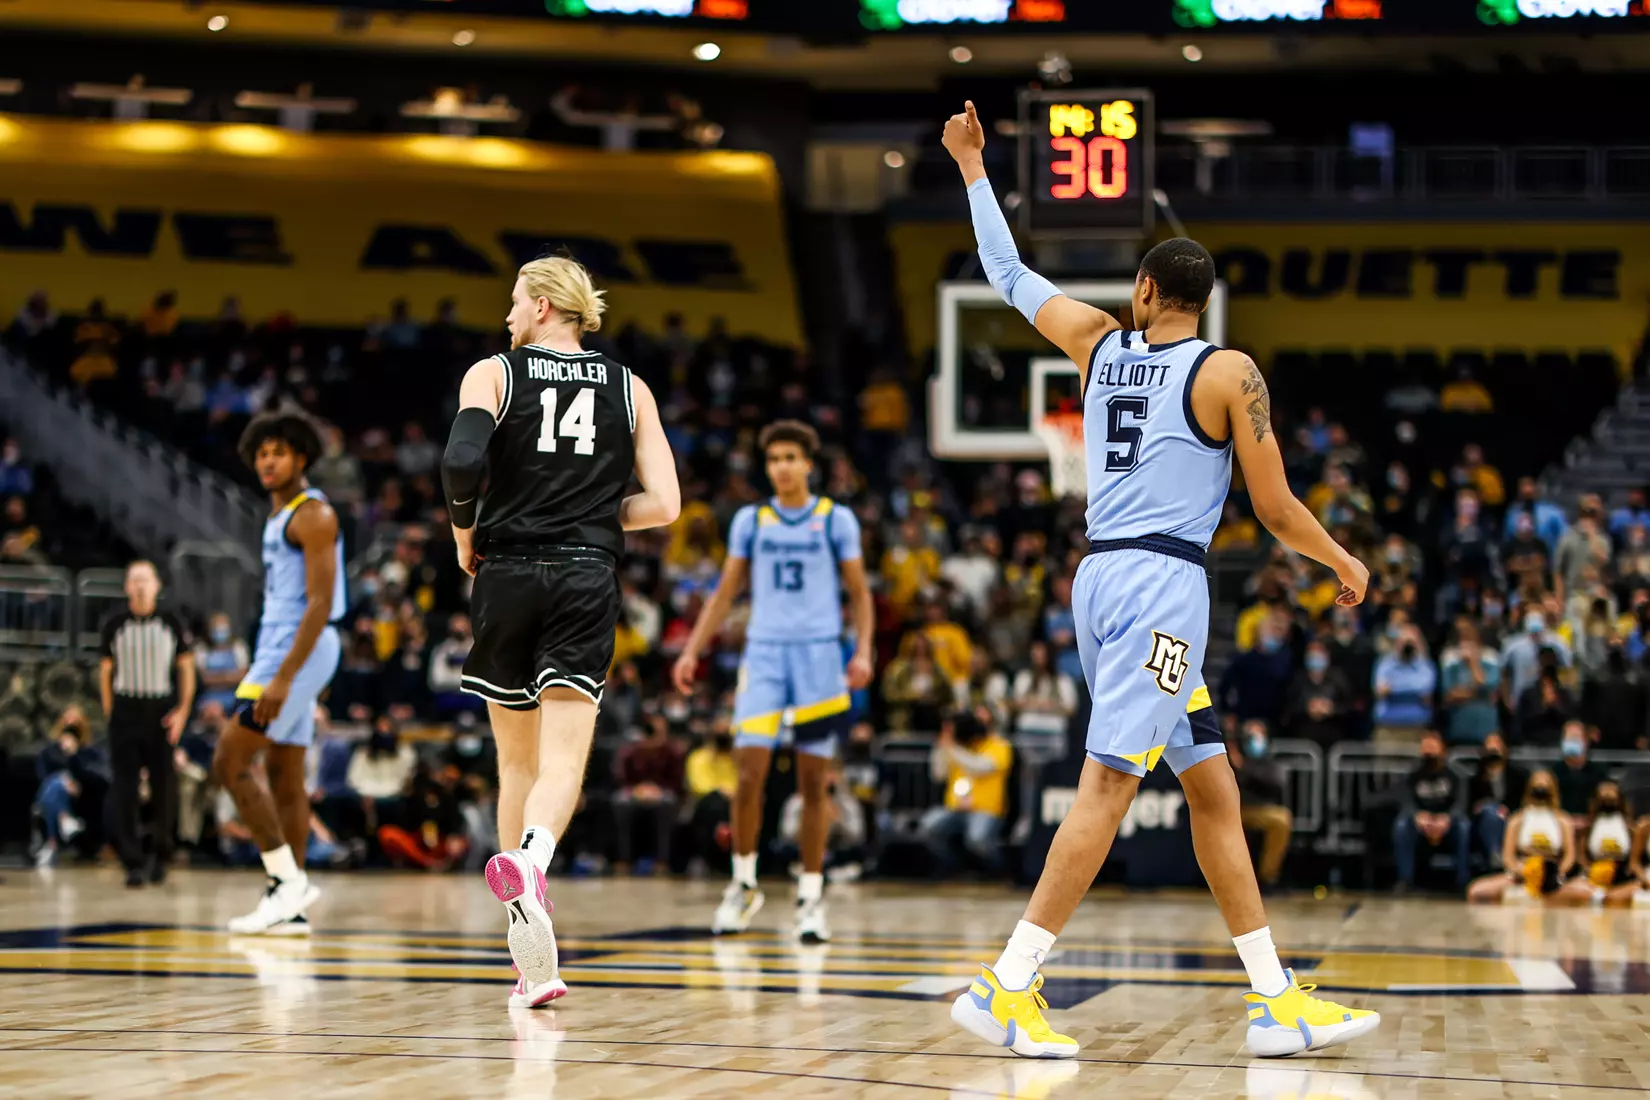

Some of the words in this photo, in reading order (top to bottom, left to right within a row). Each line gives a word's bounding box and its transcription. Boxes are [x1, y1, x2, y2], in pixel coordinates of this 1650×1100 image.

[1050, 136, 1127, 199] 30
[527, 357, 608, 385] HORCHLER
[1097, 363, 1171, 386] ELLIOTT
[537, 387, 597, 455] 14
[1104, 395, 1149, 472] 5
[773, 560, 804, 593] 13
[1142, 629, 1191, 698] MU
[1041, 786, 1184, 839] mjer
